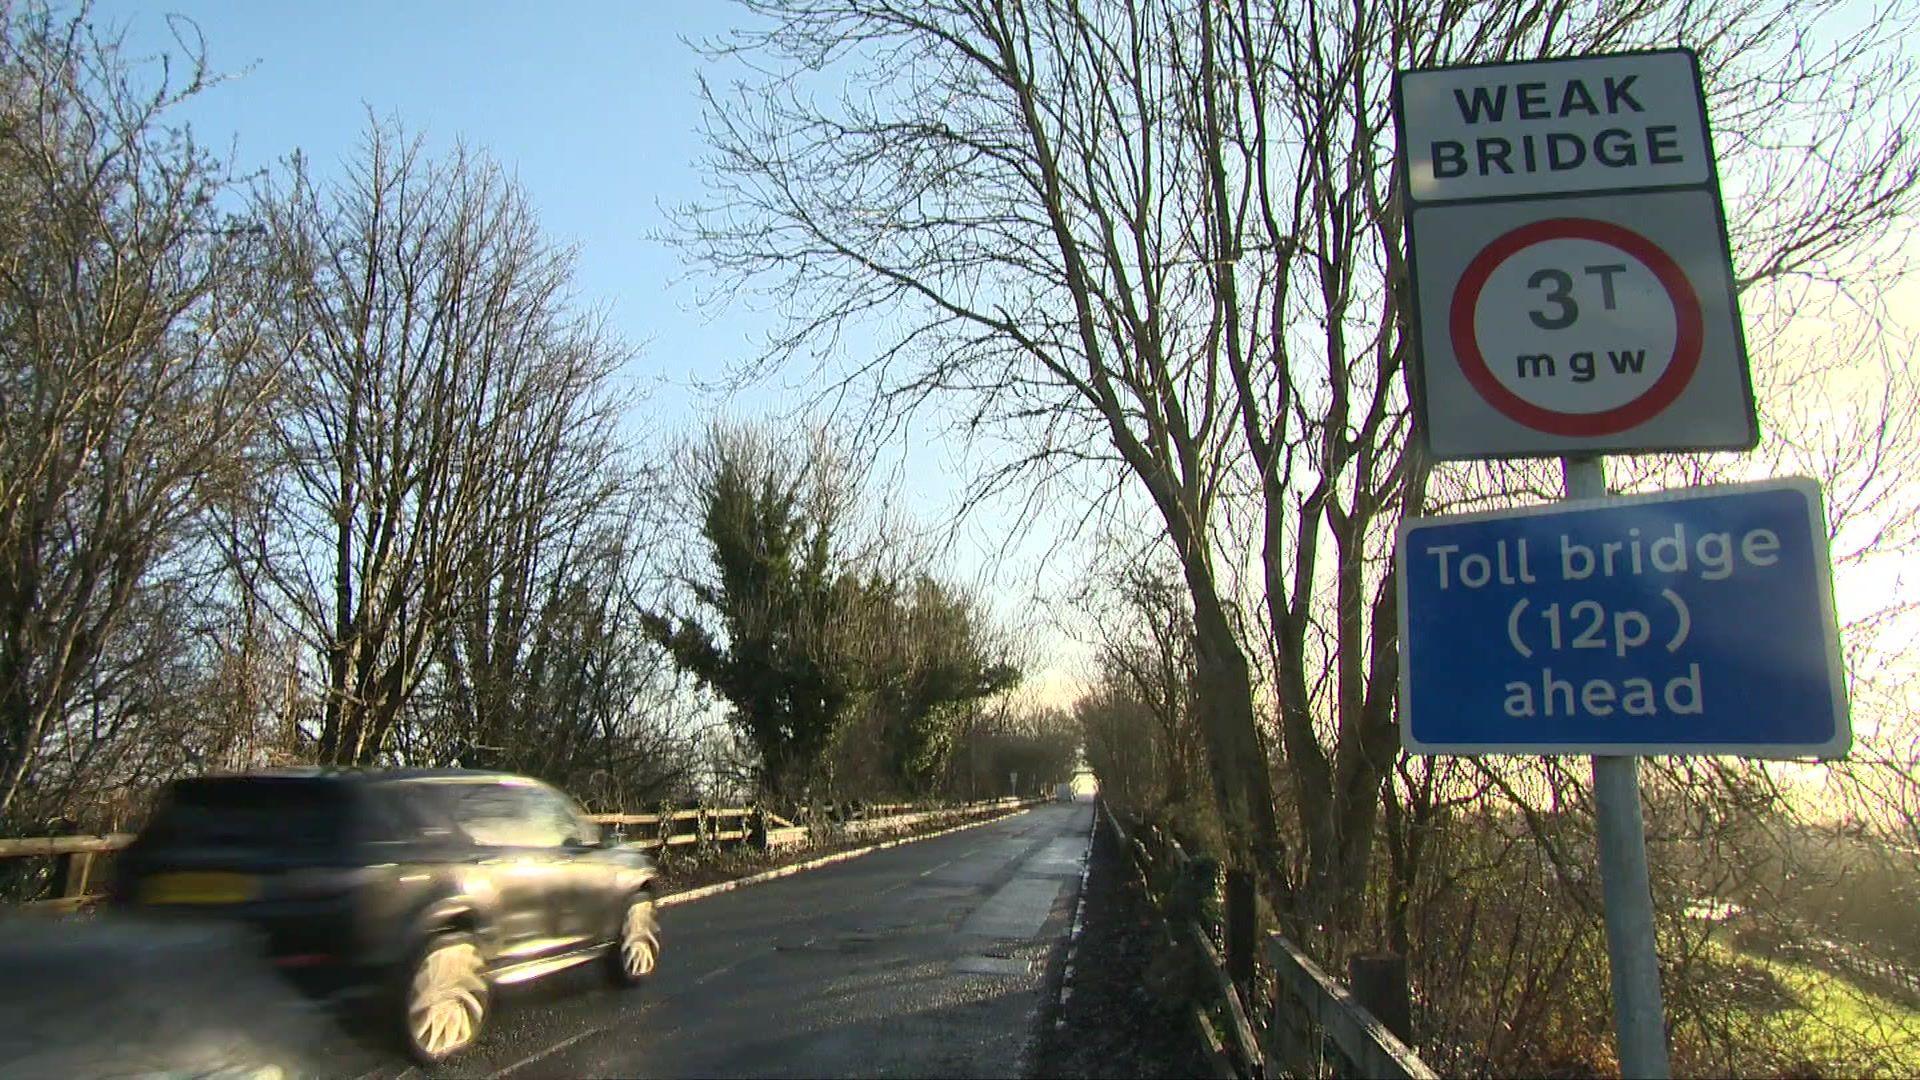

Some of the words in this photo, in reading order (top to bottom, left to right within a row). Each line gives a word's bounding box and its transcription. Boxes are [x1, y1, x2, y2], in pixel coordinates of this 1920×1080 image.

[1454, 74, 1645, 124] WEAK
[1431, 125, 1684, 178] BRIDGE
[1428, 537, 1536, 590] Toll
[1560, 524, 1780, 581] bridge
[1507, 588, 1691, 658] (12p)
[1503, 662, 1704, 718] ahead
